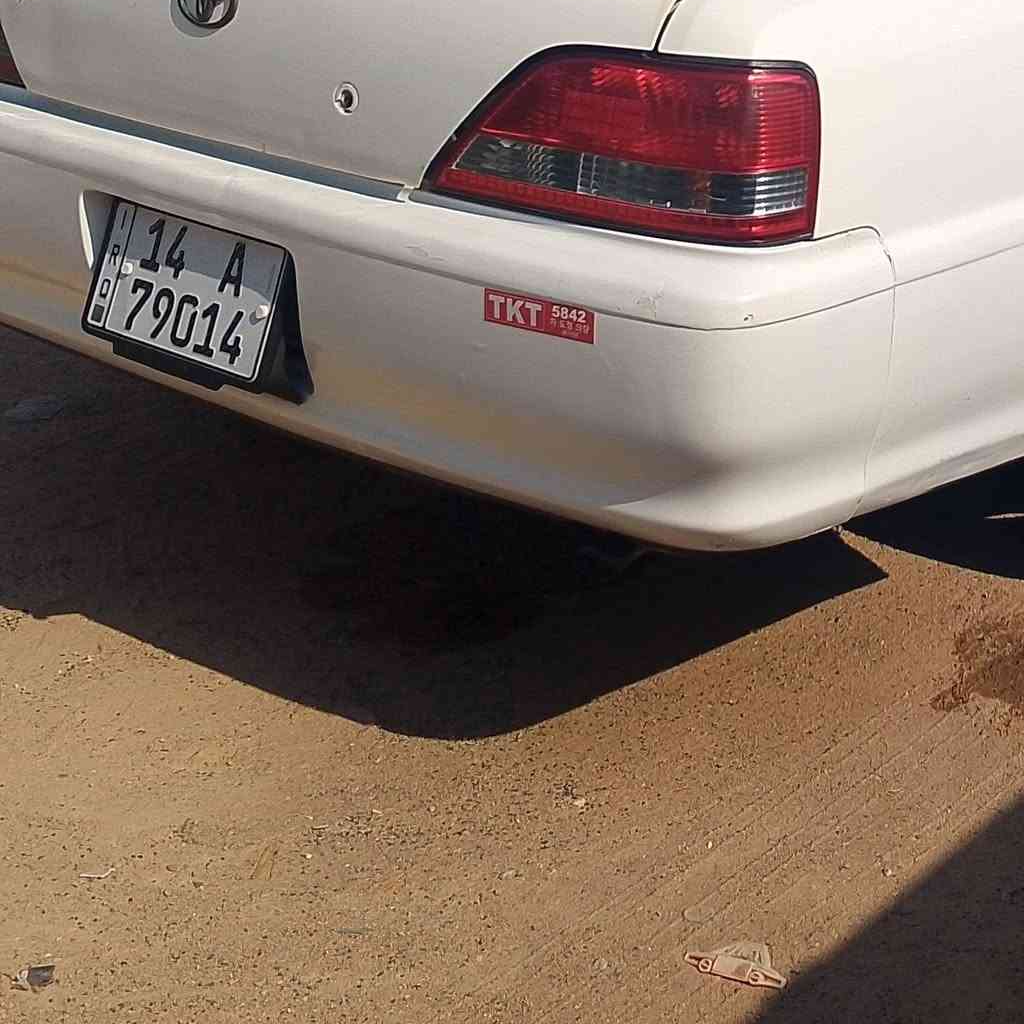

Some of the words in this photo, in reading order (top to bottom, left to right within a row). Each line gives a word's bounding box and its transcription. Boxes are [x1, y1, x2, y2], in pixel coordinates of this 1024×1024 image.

[139, 217, 188, 280] 14
[217, 241, 247, 298] A
[124, 277, 245, 365] 79014
[488, 293, 543, 327] TKT
[551, 305, 586, 323] 5842
